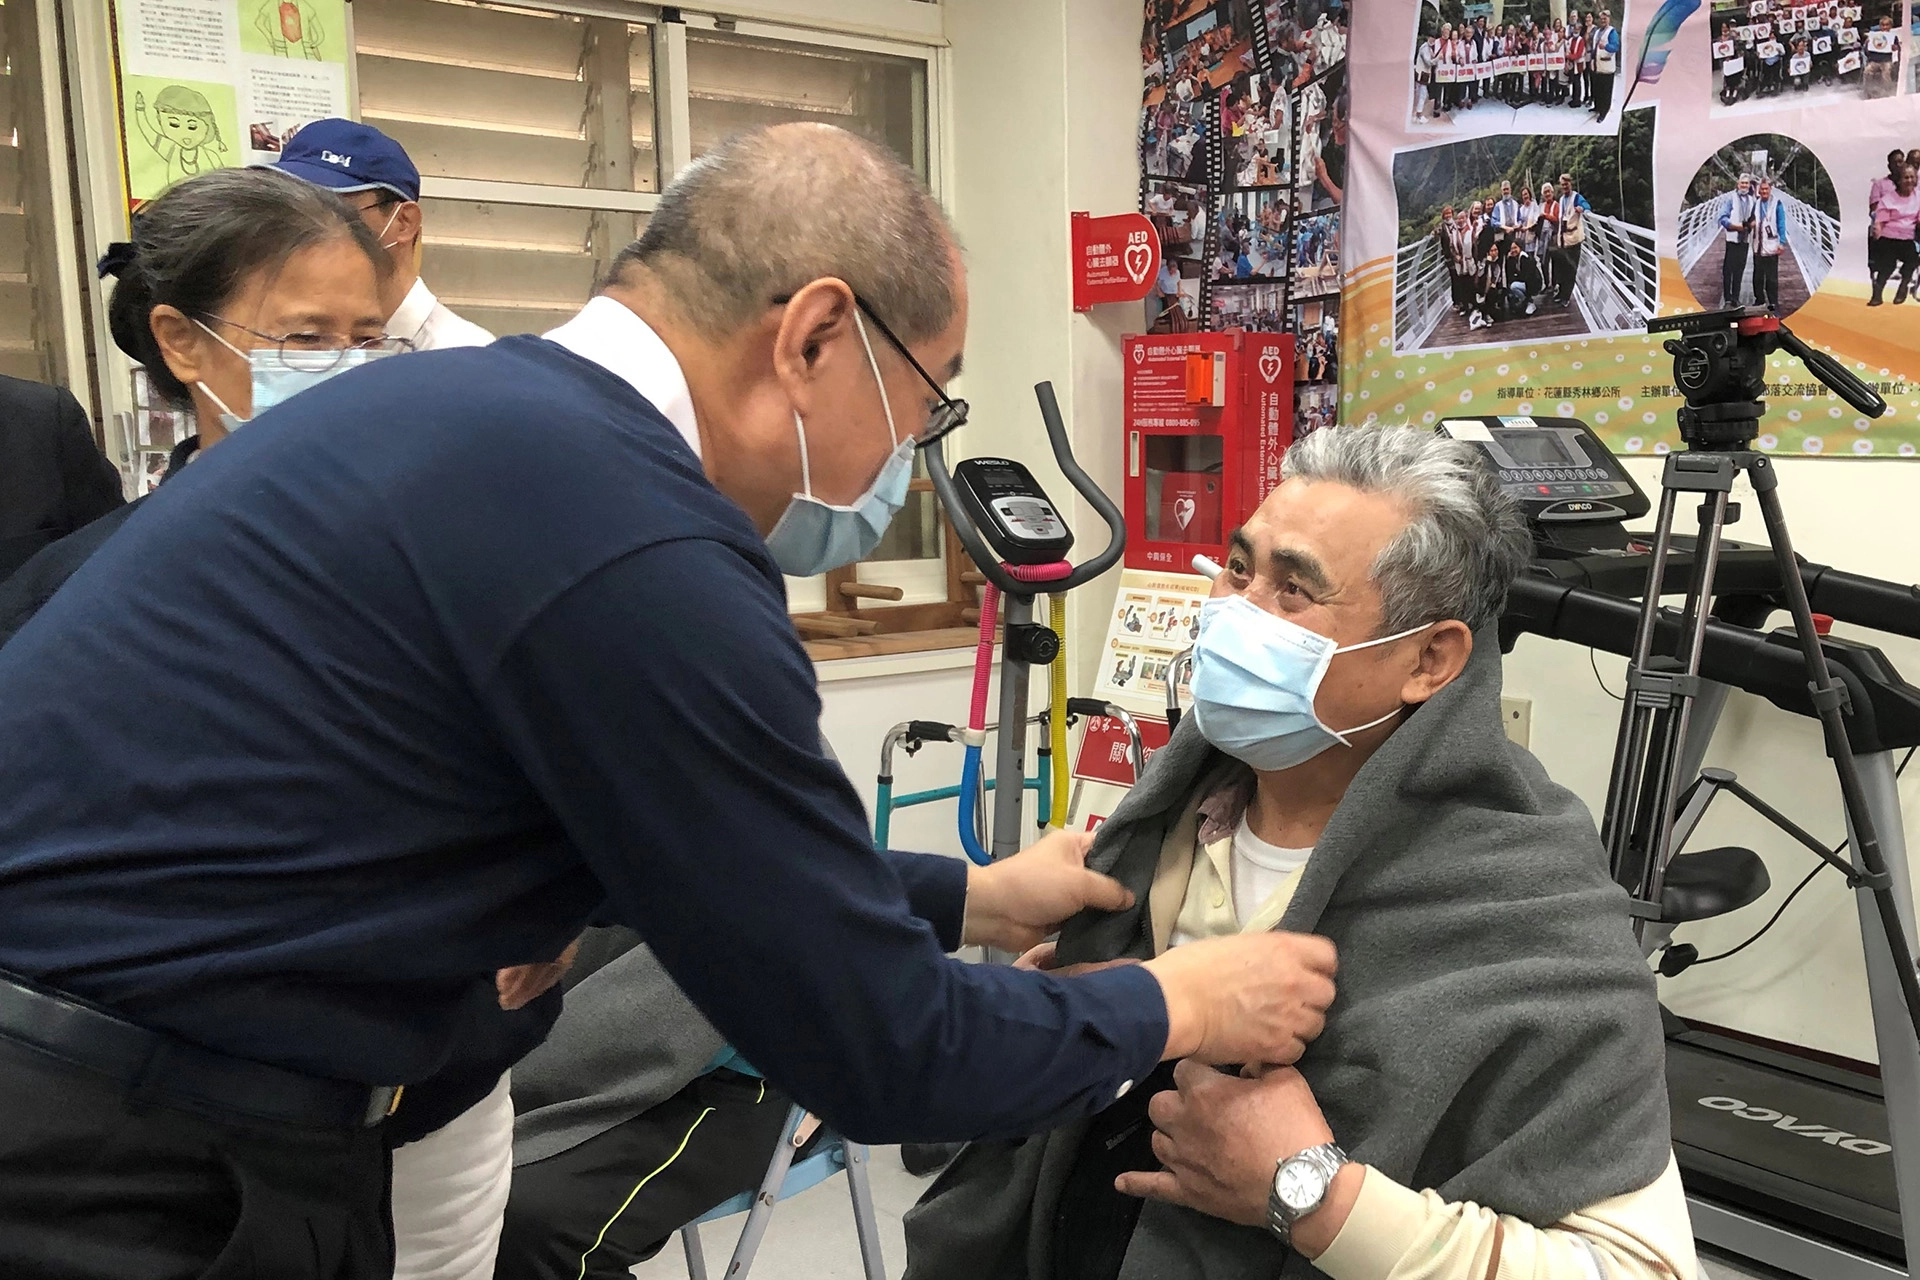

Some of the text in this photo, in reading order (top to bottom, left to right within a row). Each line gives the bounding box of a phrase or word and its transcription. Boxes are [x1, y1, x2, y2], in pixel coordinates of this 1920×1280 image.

[1128, 231, 1149, 244] AED
[1262, 346, 1280, 356] AED
[1260, 391, 1268, 437] Automated
[1259, 439, 1267, 474] External
[1698, 1096, 1893, 1156] DYACO
